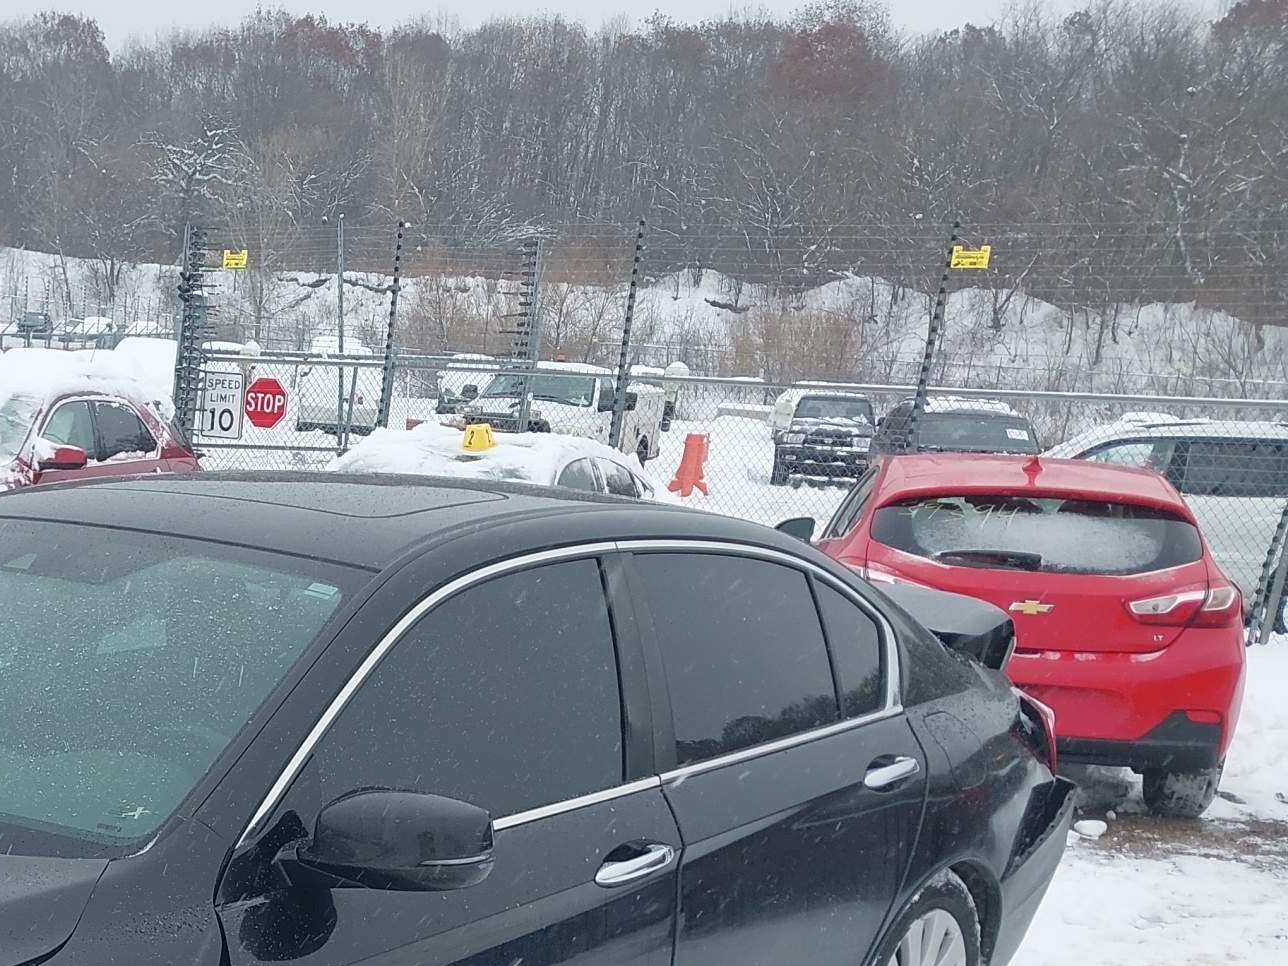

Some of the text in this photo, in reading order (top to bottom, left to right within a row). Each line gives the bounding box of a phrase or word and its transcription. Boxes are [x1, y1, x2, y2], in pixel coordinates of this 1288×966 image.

[207, 378, 241, 390] SPEED
[209, 392, 236, 404] LIMIT
[246, 392, 284, 414] STOP
[209, 407, 234, 432] 10
